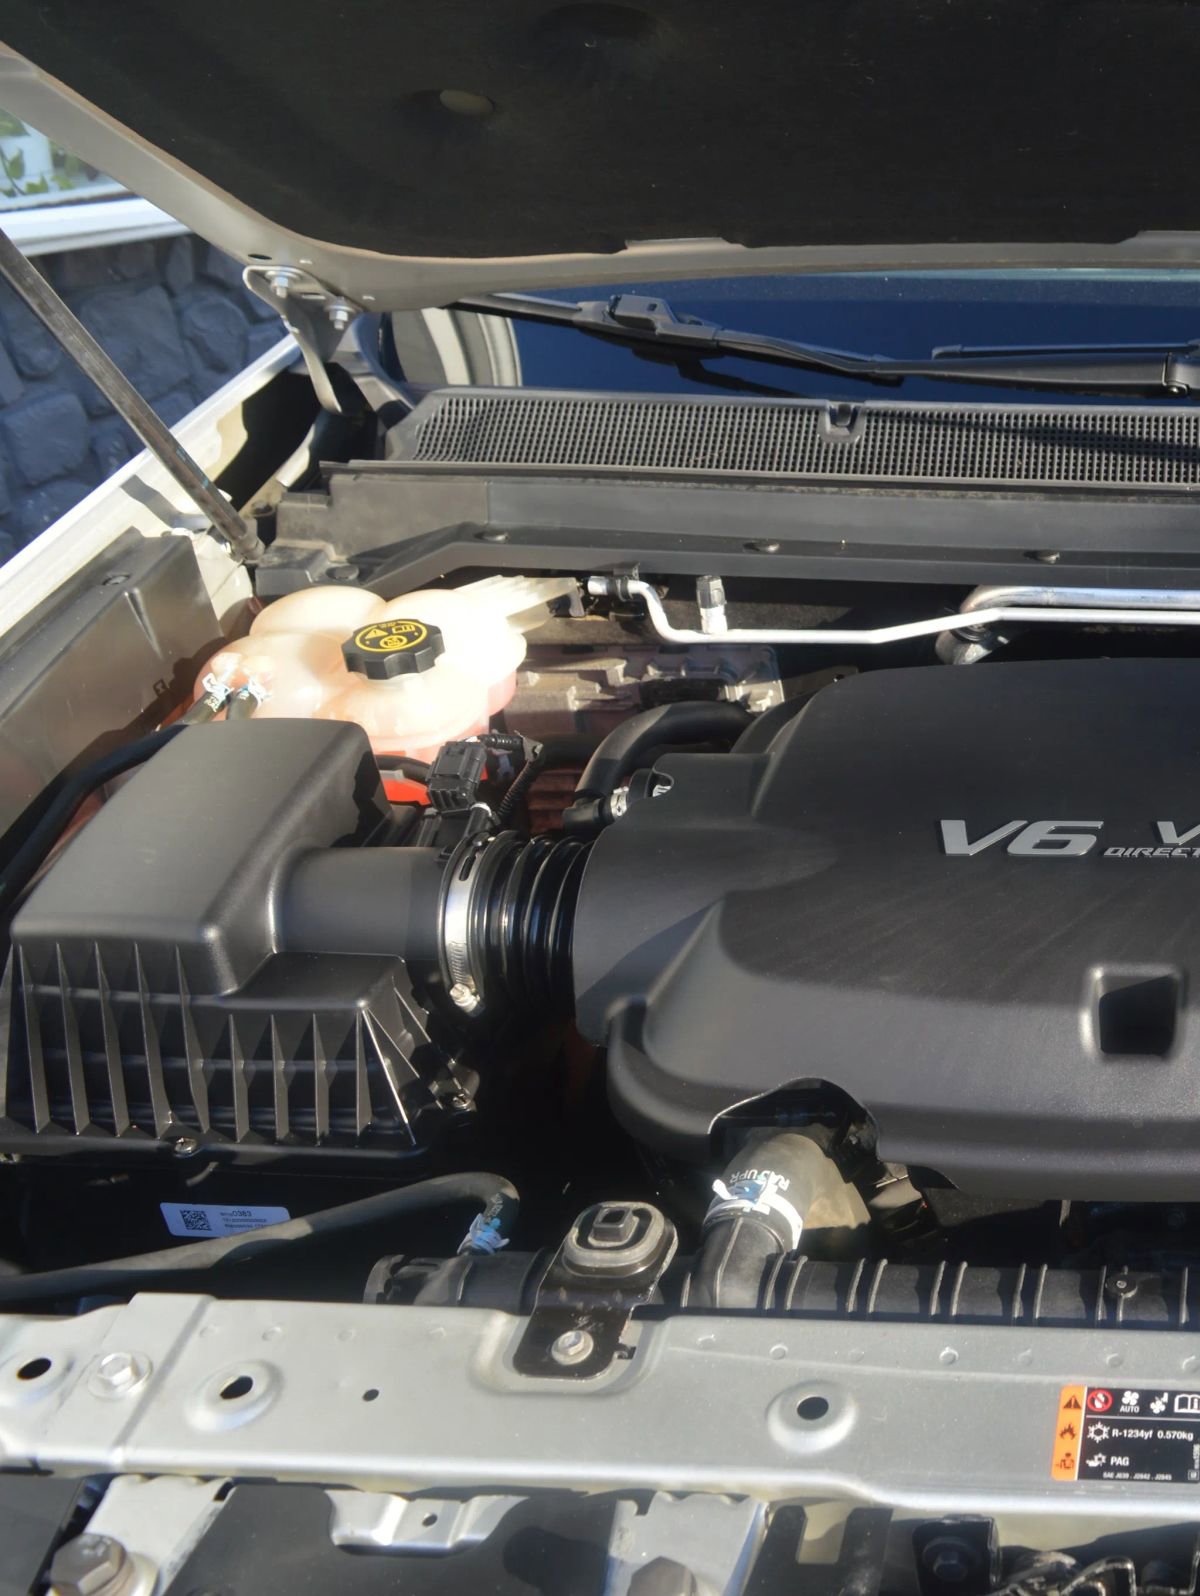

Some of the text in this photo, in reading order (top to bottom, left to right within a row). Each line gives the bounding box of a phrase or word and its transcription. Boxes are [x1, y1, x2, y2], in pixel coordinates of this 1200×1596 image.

[940, 819, 1104, 857] V6
[1119, 1405, 1140, 1413] AUTO
[1111, 1428, 1194, 1441] R-1234yf 0.570kg
[1110, 1456, 1130, 1466] PAG
